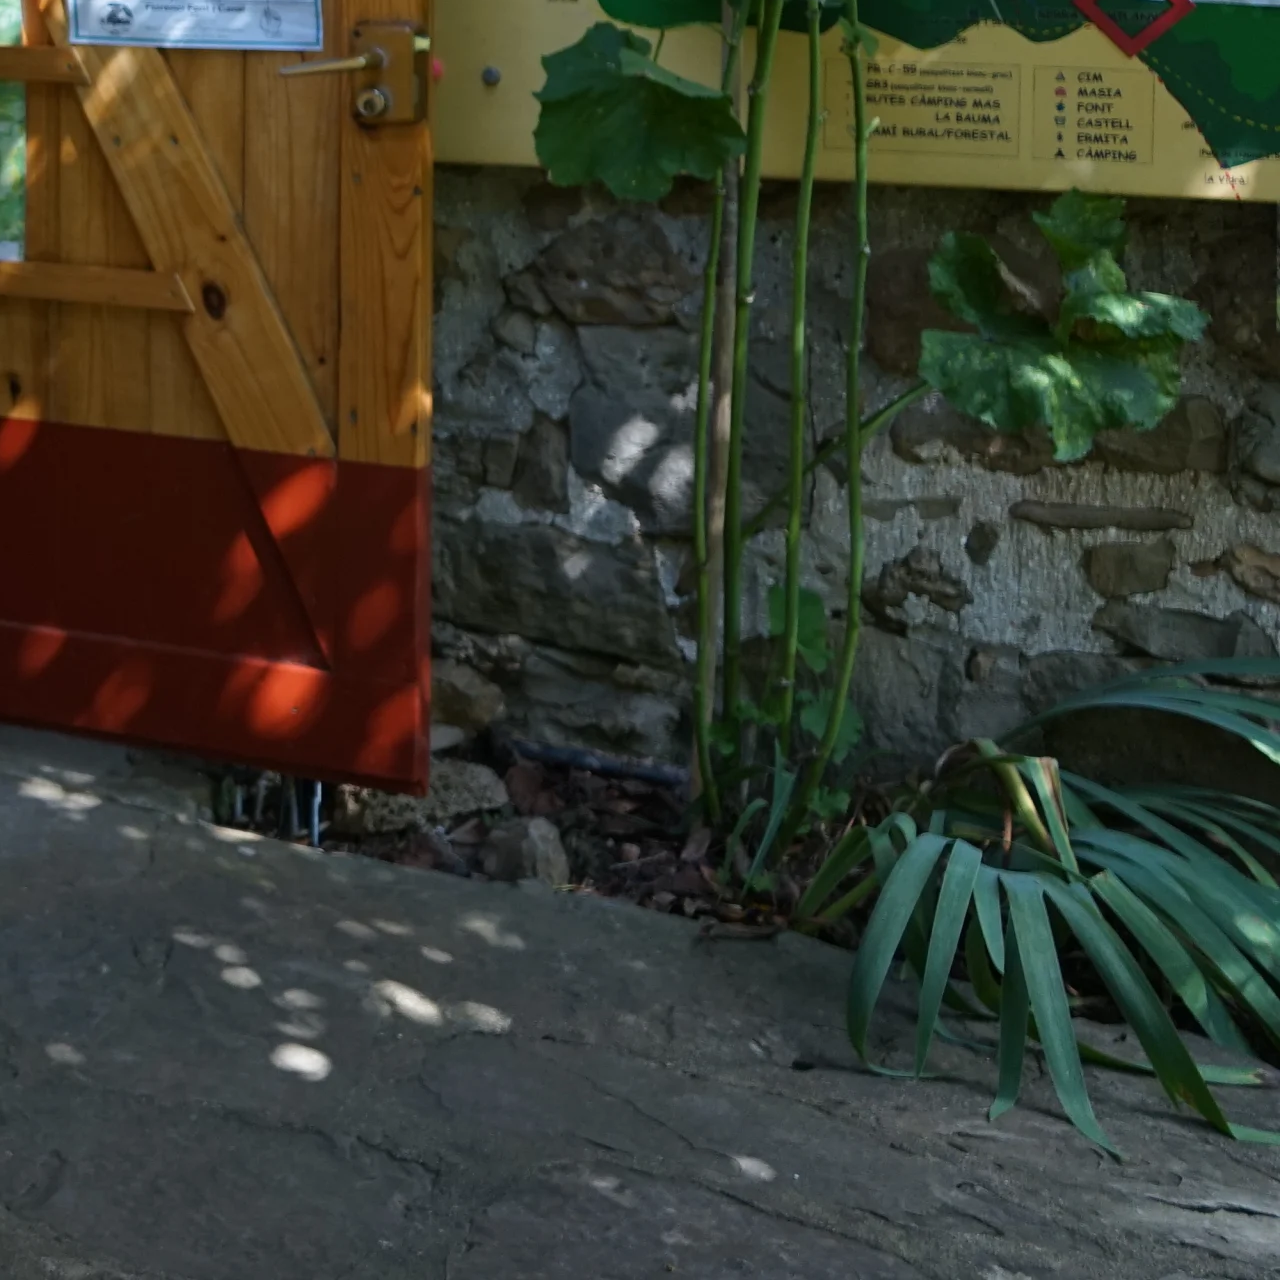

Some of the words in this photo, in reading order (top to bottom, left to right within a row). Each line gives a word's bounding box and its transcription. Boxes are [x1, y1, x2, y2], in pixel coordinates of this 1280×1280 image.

[1077, 71, 1104, 83] CIM
[1077, 86, 1122, 99] MASIA
[866, 94, 906, 107] RUTES
[972, 98, 1001, 110] MAS
[1077, 102, 1115, 114] FONT
[935, 112, 951, 123] LA
[956, 113, 1001, 126] BAUMA
[1076, 117, 1133, 131] CASTELL
[870, 124, 897, 137] AMÍ
[902, 127, 1012, 144] RURAL/FORESTAL
[1076, 132, 1129, 145] ERMITA
